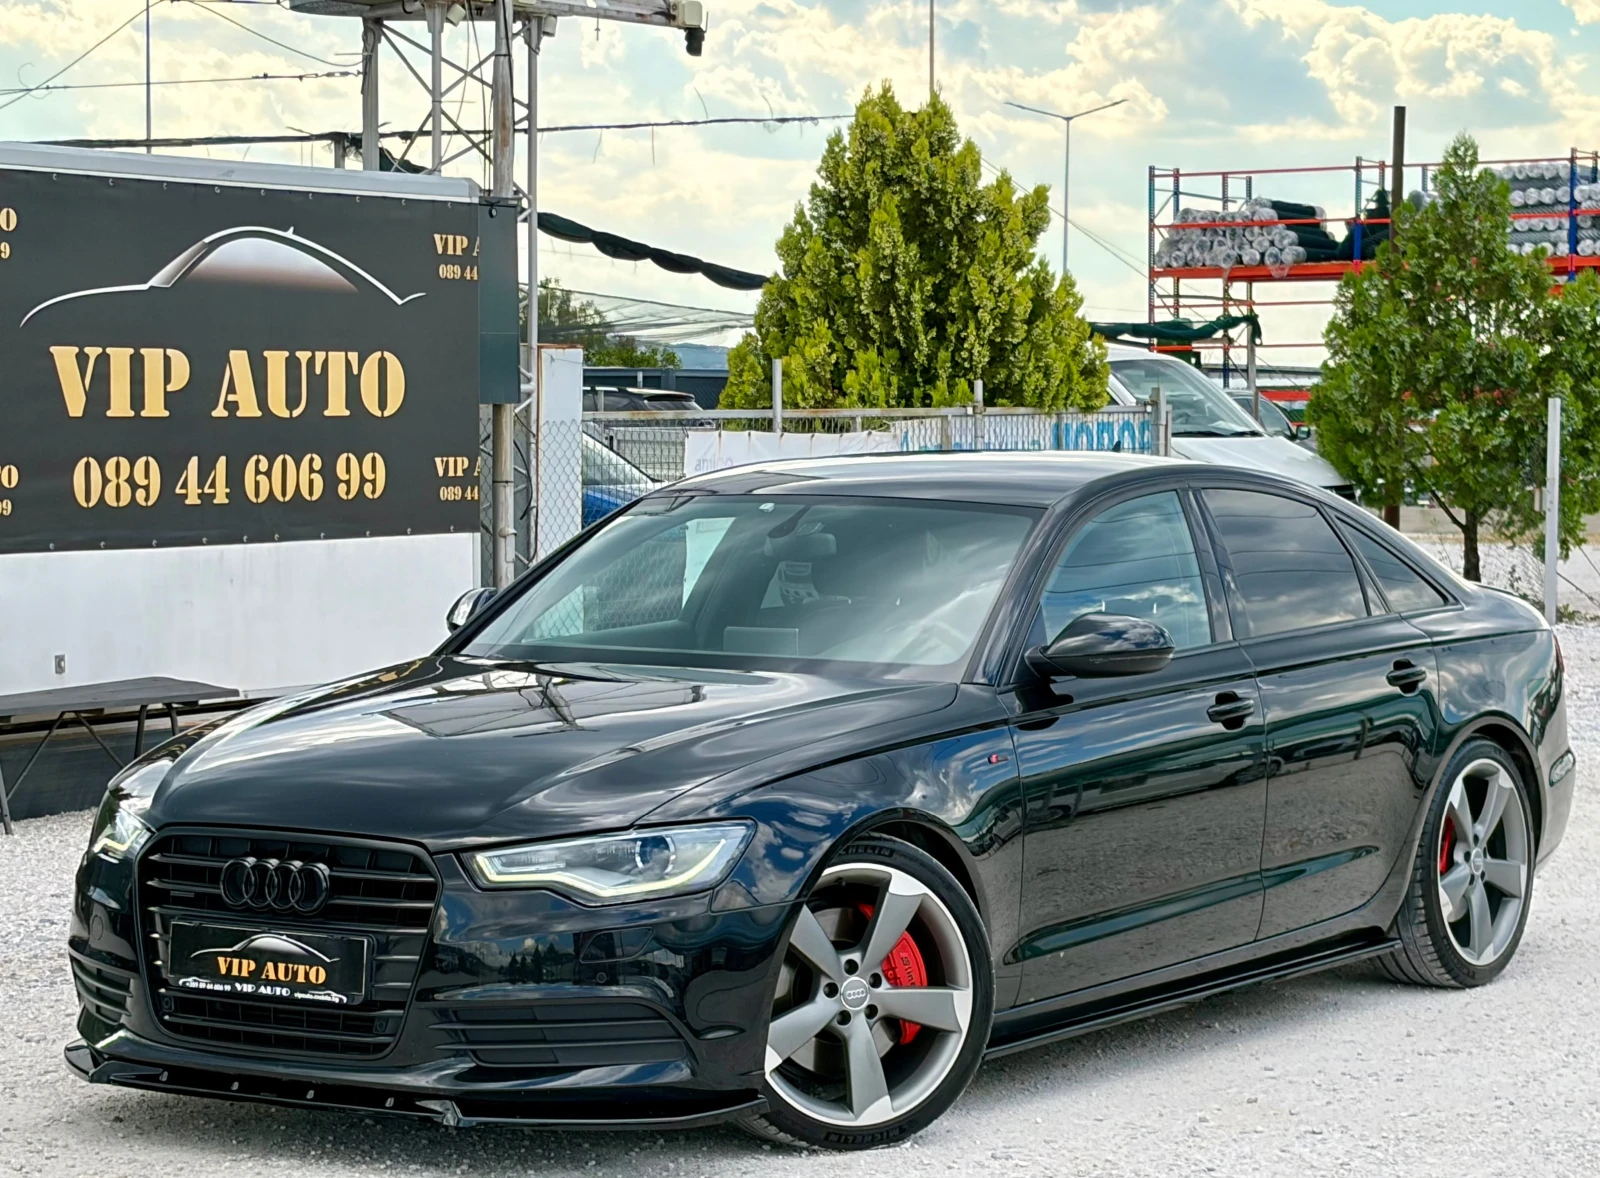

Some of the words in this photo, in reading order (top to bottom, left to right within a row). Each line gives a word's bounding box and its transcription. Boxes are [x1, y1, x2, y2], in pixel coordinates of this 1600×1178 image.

[433, 233, 468, 256] VIP
[438, 263, 461, 280] 089
[463, 264, 479, 280] 44
[49, 345, 190, 418] VIP
[210, 349, 406, 418] AUTO
[434, 456, 469, 477] VIP
[73, 455, 161, 508] 089
[174, 455, 231, 505] 44
[244, 453, 324, 504] 606
[335, 452, 386, 500] 99
[439, 486, 462, 501] 089
[464, 485, 479, 500] 44
[216, 956, 256, 977] VIP
[260, 961, 327, 985] AUTO
[234, 982, 256, 992] VIP
[257, 986, 291, 997] AUTO
